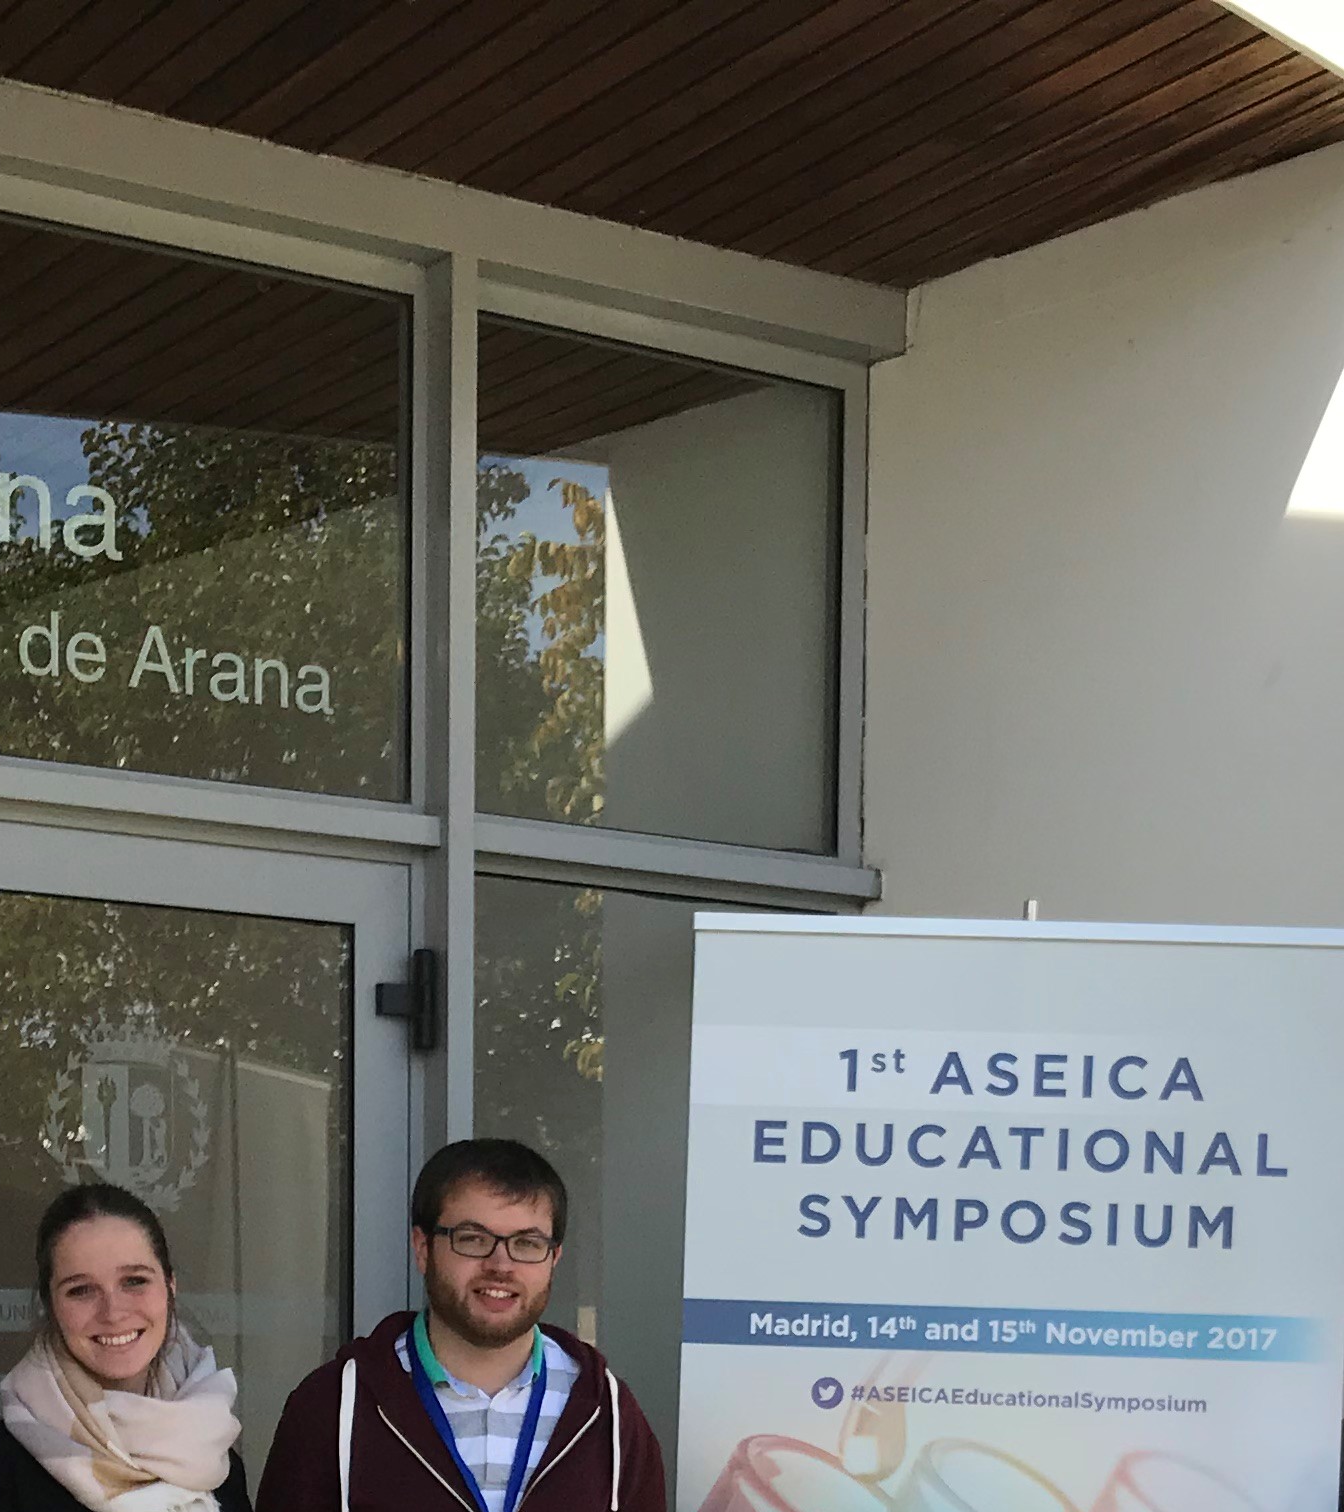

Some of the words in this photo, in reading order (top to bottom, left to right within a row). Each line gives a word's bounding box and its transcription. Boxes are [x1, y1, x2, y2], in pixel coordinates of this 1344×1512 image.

[19, 608, 107, 684] de
[130, 622, 335, 716] Arana
[838, 1048, 906, 1093] 1st
[929, 1051, 1205, 1102] ASEICA
[752, 1119, 1289, 1178] EDUCATIONAL
[797, 1194, 1234, 1250] SYMPOSIUM
[749, 1312, 859, 1342] Madrid,
[866, 1315, 917, 1341] 14th
[924, 1318, 980, 1343] and
[988, 1318, 1037, 1345] 15th
[1045, 1321, 1199, 1350] November
[1207, 1325, 1278, 1352] 2017
[850, 1384, 1208, 1415] #ASEICAEducationalSymposium
